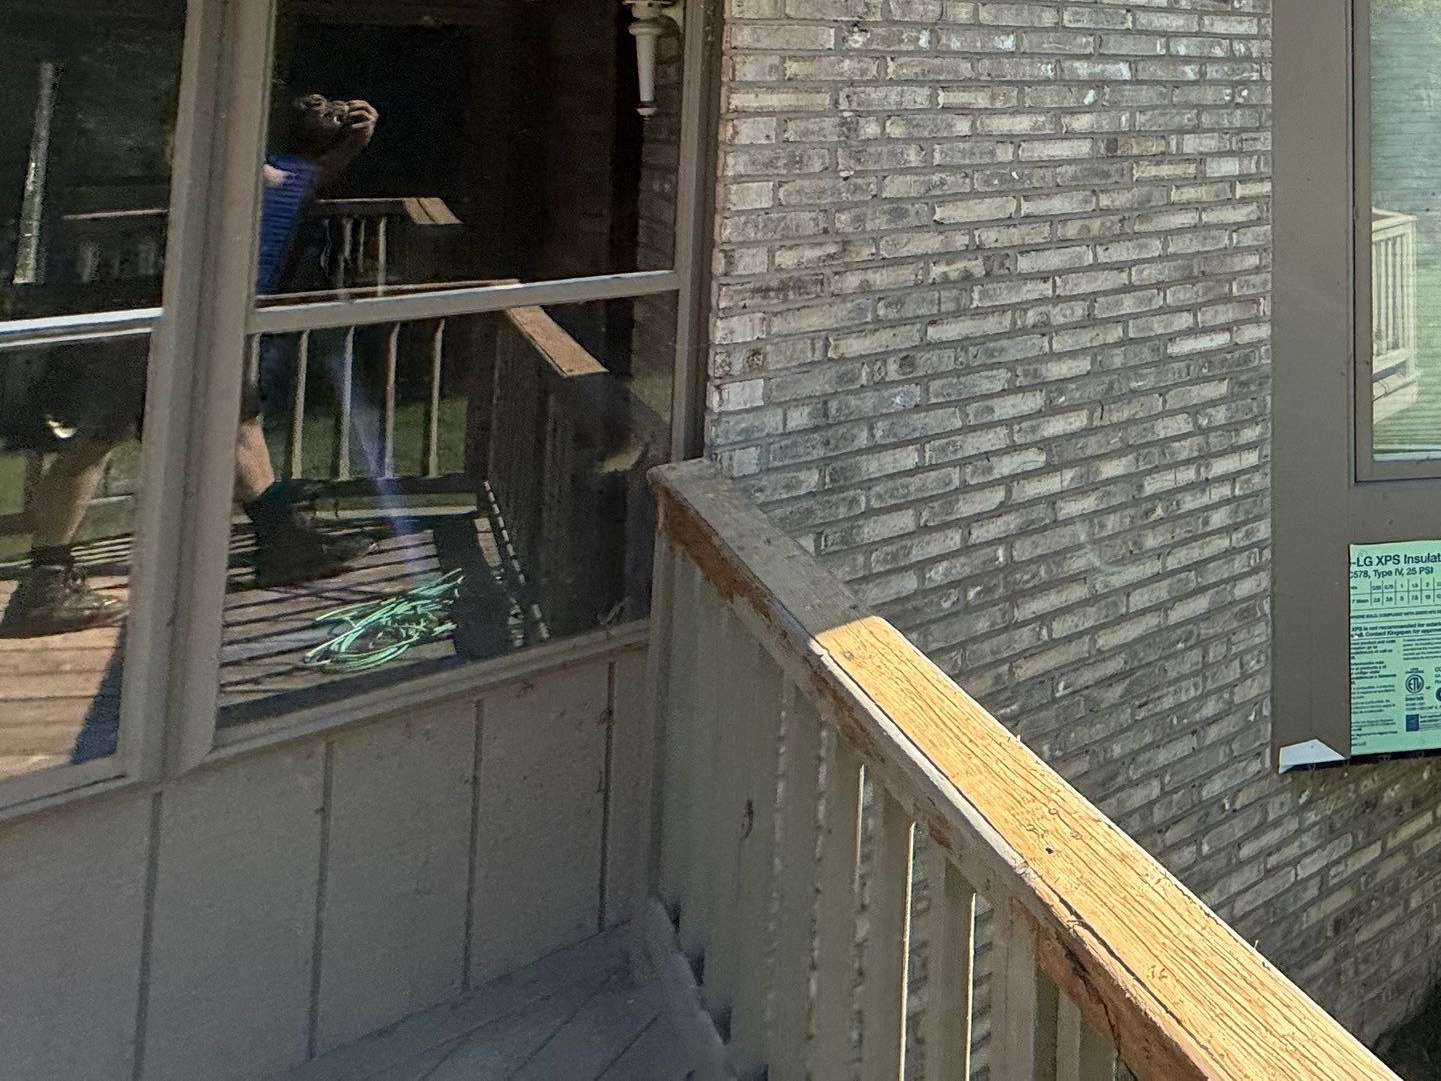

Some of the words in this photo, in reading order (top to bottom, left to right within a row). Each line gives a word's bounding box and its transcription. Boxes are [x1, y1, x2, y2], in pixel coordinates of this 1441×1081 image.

[1376, 555, 1400, 566] XPS
[1373, 569, 1392, 579] Type
[1395, 568, 1404, 577] IV,
[1406, 567, 1417, 575] 25
[1418, 566, 1434, 574] PSI
